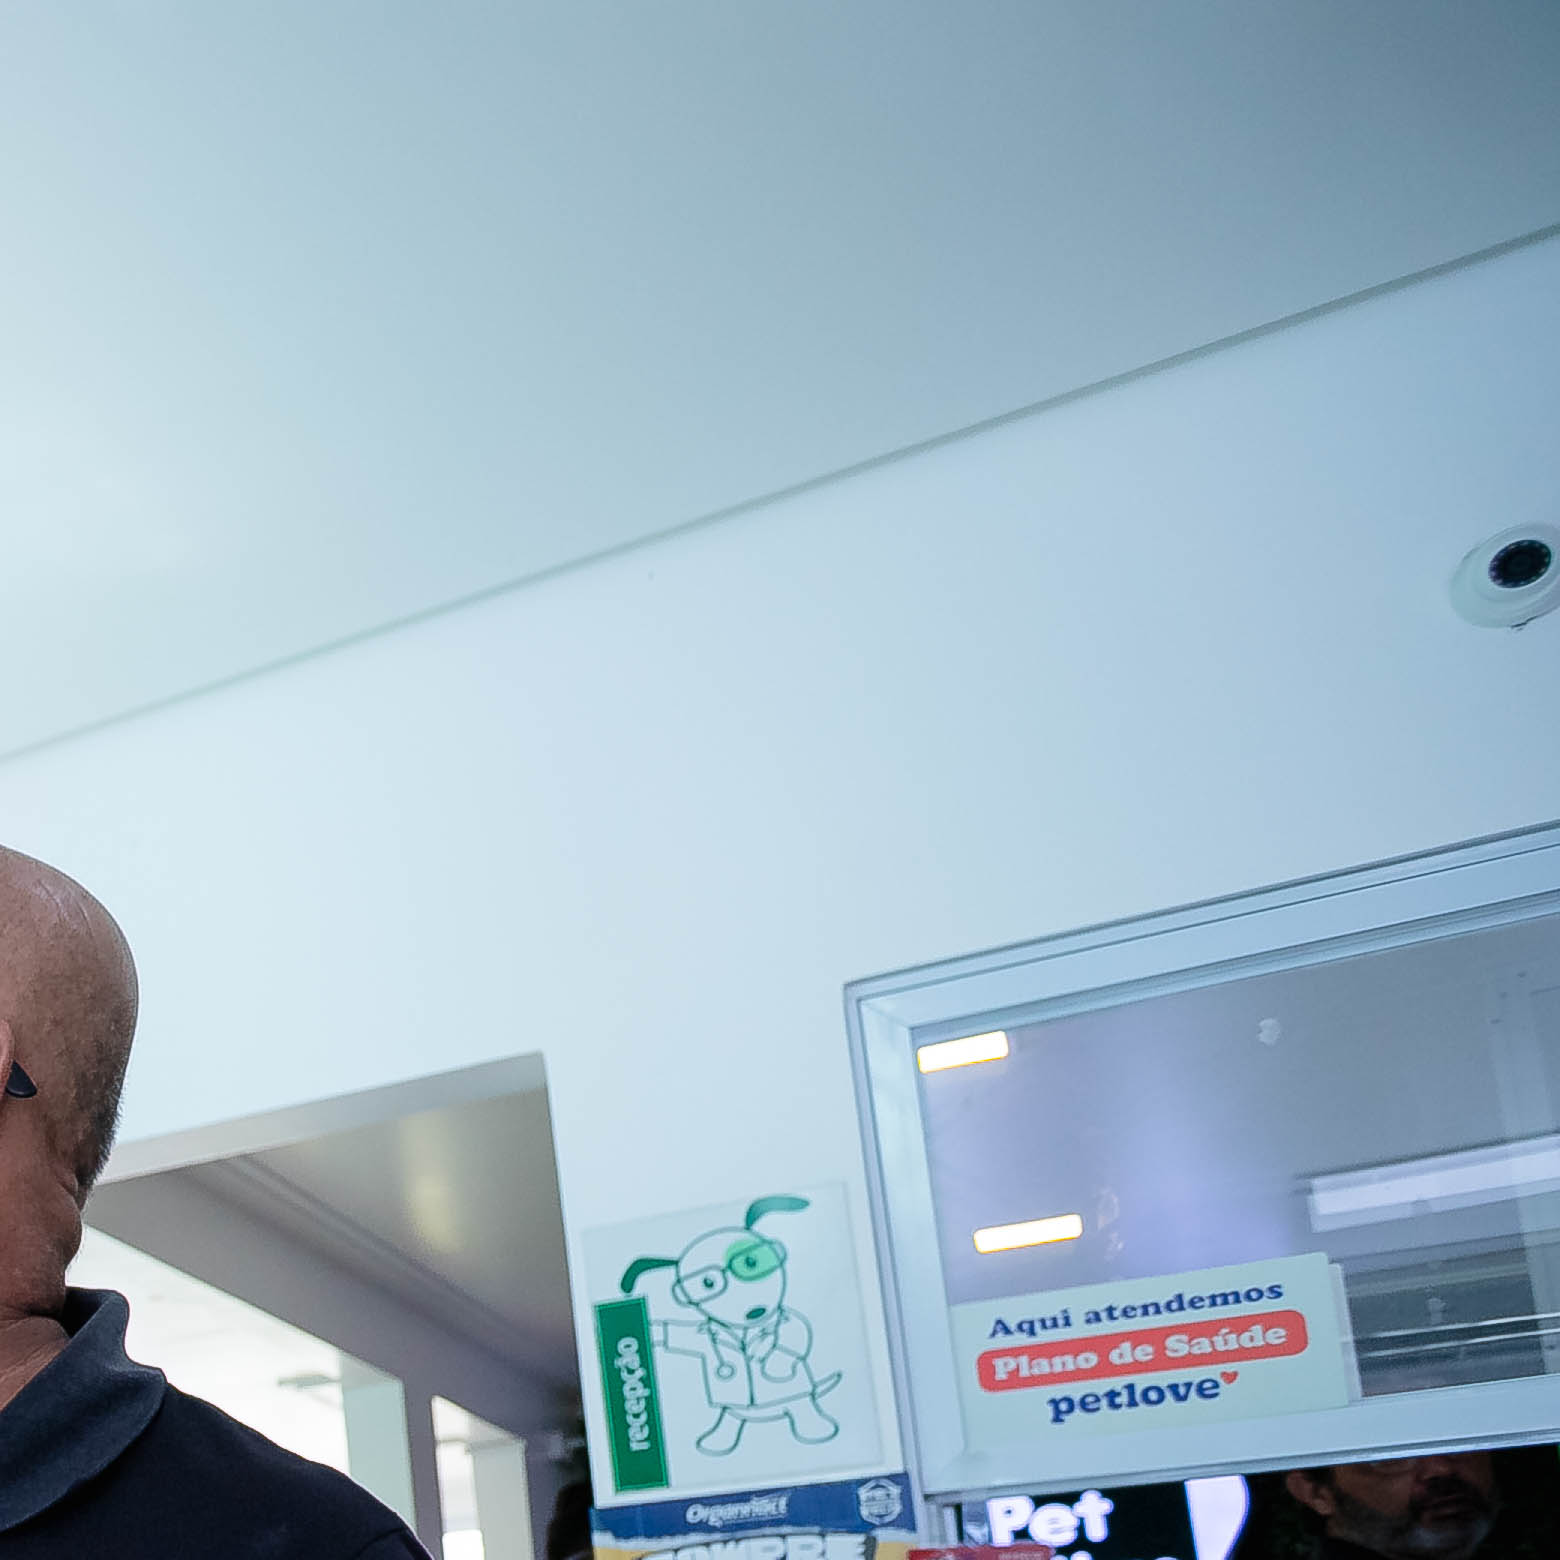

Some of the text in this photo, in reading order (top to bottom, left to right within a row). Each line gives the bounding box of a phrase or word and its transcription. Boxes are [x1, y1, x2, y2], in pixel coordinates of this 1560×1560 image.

[988, 1280, 1285, 1341] Aqui atendemos
[991, 1322, 1289, 1384] Plano de Saúde
[613, 1336, 651, 1453] recepção
[1047, 1377, 1221, 1425] petlove
[986, 1489, 1115, 1547] Pet
